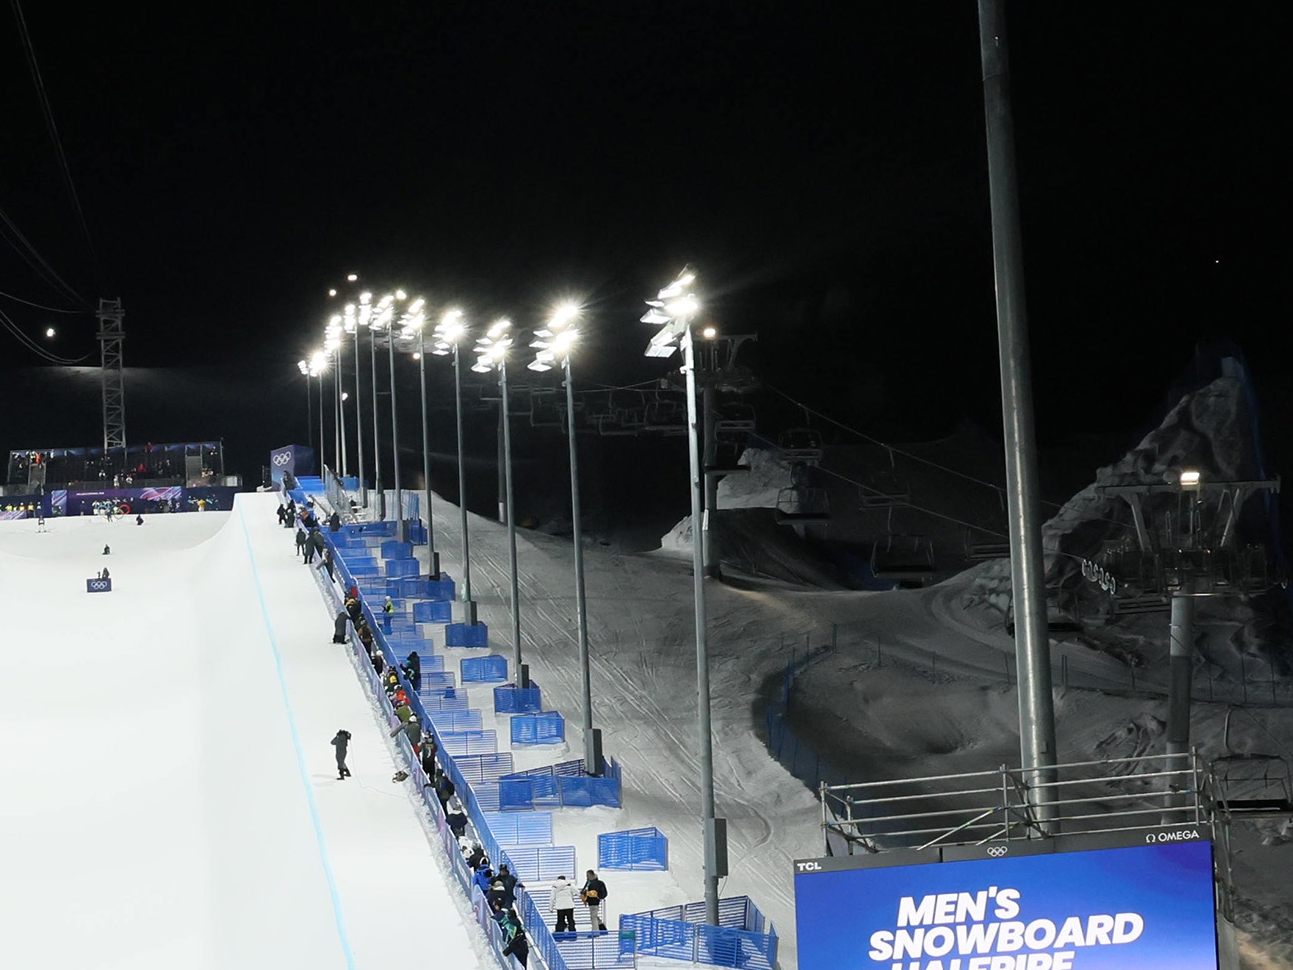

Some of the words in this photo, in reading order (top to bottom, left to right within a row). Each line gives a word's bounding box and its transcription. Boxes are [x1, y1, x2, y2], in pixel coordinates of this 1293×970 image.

[1158, 830, 1199, 842] OMEGA
[797, 862, 822, 872] TCL
[897, 886, 1021, 927] MEN'S
[868, 912, 1144, 961] SNOWBOARD
